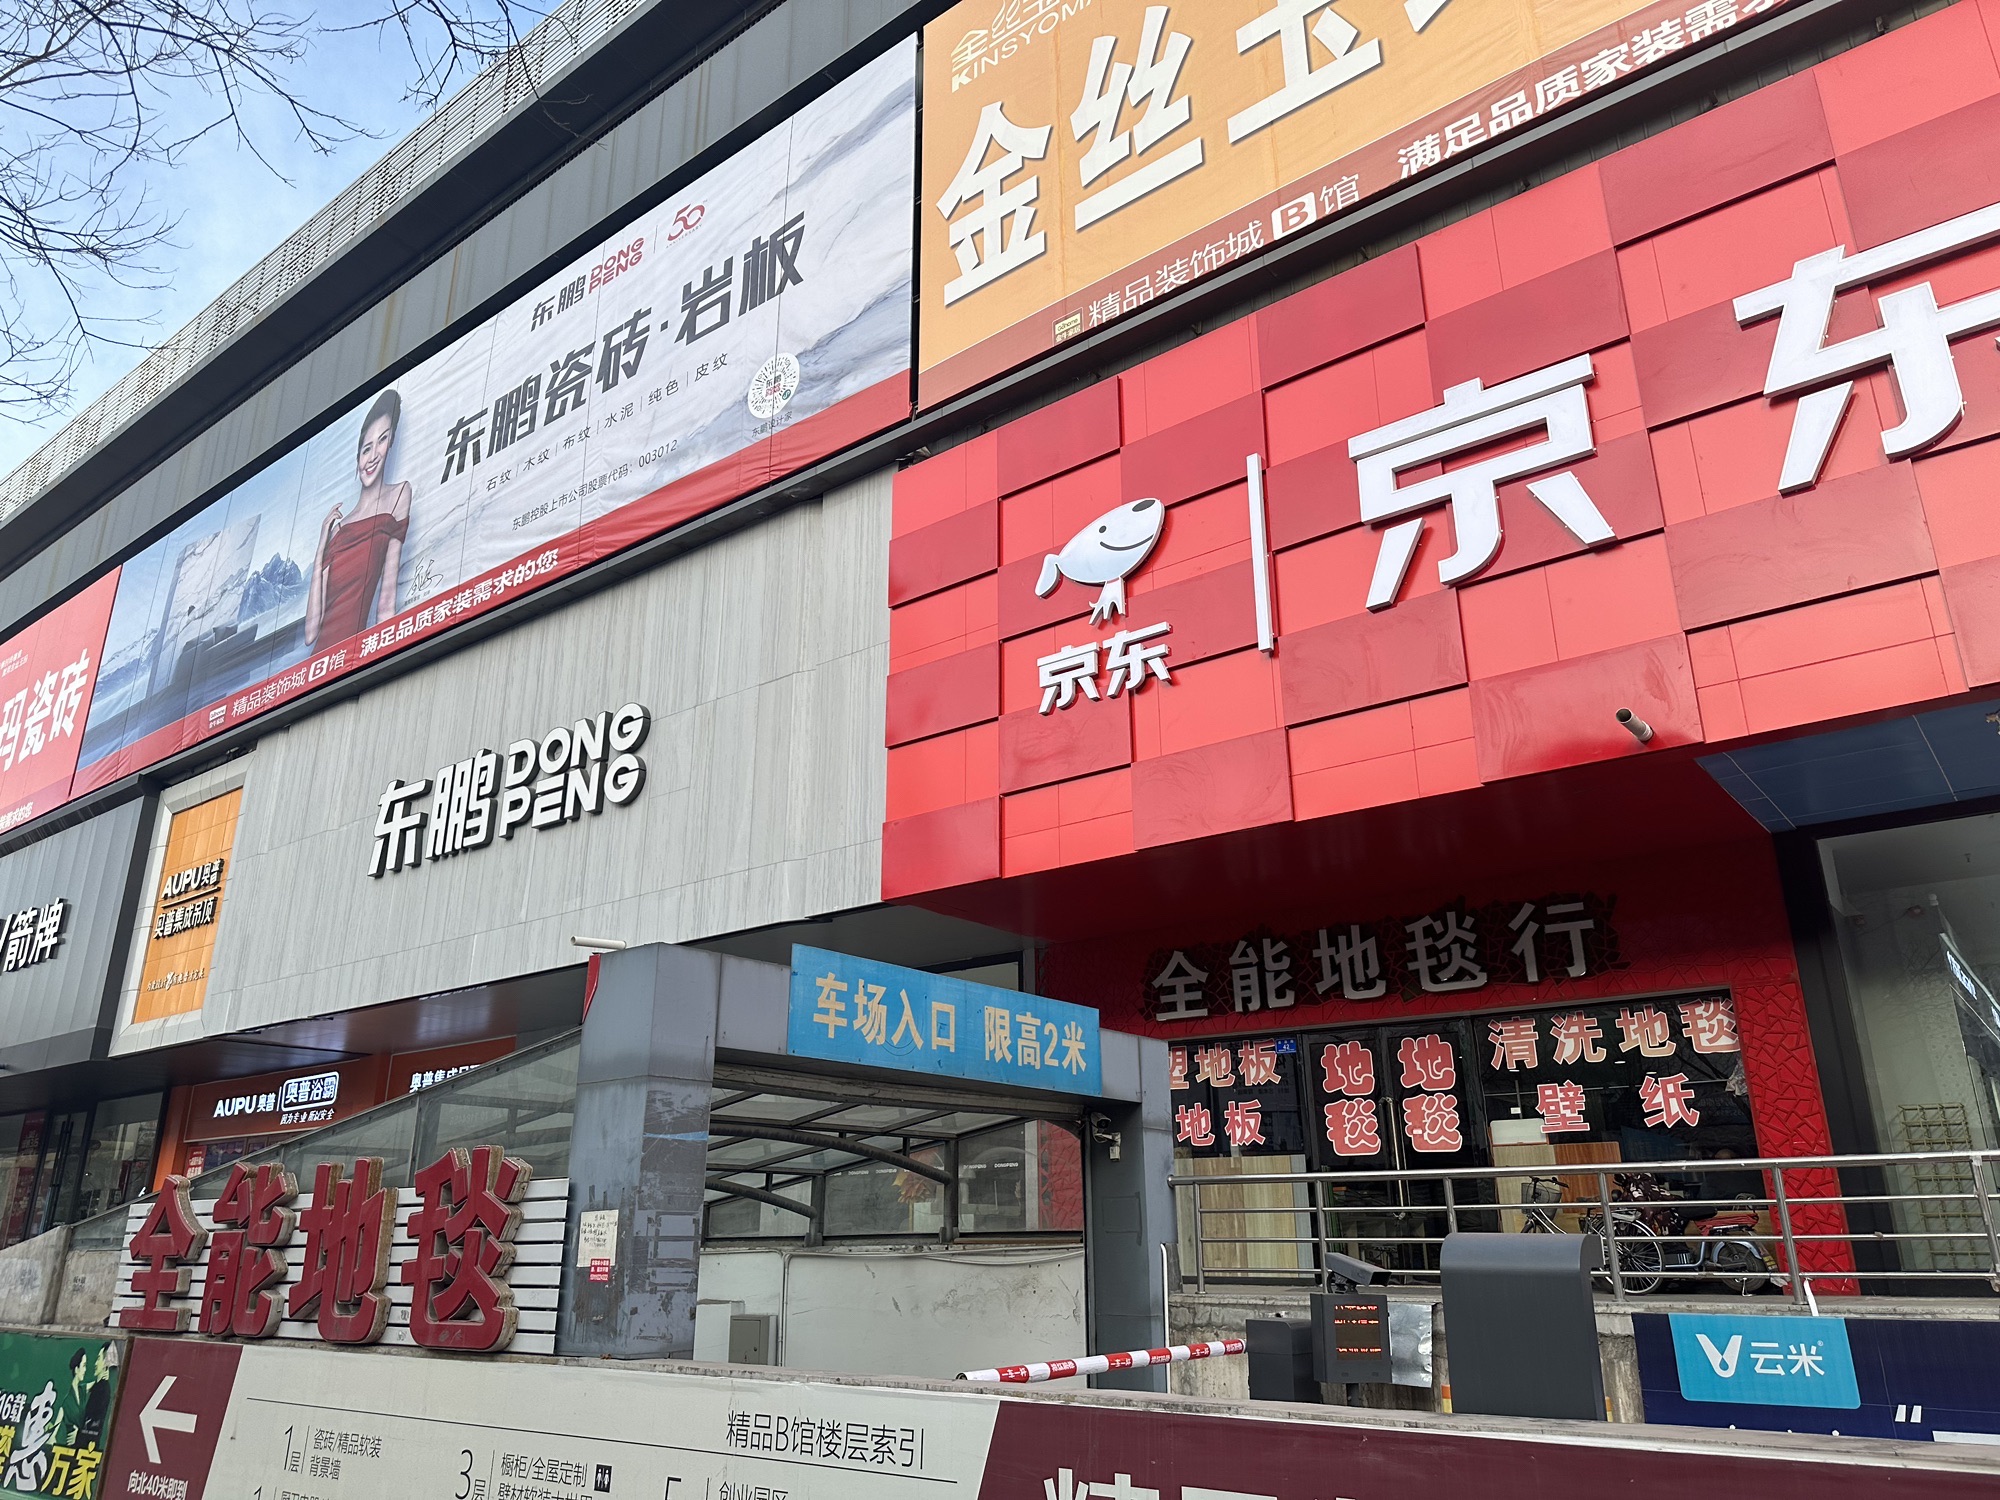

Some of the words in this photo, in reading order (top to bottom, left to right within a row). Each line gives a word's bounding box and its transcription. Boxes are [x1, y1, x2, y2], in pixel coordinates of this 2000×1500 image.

[951, 0, 1092, 94] KINSYOM
[936, 0, 1453, 307] 金丝玉
[588, 251, 643, 294] PENG
[590, 237, 645, 280] DONG
[530, 274, 587, 332] 东鹏
[486, 469, 512, 493] 石纹
[523, 448, 550, 471] 木纹
[562, 427, 591, 450] 布纹
[603, 402, 634, 429] 水泥
[648, 379, 679, 406] 纯色
[694, 353, 728, 383] 皮纹
[638, 439, 678, 468] 003012
[359, 547, 559, 659] 满足品质家装需求的您
[1036, 621, 1173, 715] 京东
[505, 702, 651, 790] DONG
[367, 747, 503, 878] 东鹏
[498, 752, 647, 840] PENG
[1151, 901, 1596, 1022] 全能地毯行
[812, 971, 956, 1054] 车场入口
[983, 1005, 1088, 1076] 限高2米
[1487, 997, 1742, 1071] 清洗地毯
[285, 1077, 337, 1105] 奥普浴霸
[409, 1064, 481, 1094] 奥普集
[1320, 1040, 1382, 1157] 地毯
[1397, 1033, 1463, 1153] 地毯
[1175, 1099, 1266, 1147] 地板
[119, 1145, 533, 1351] 全能地毯
[1749, 1341, 1826, 1378] 云米
[308, 1454, 342, 1481] 背景墙
[313, 1427, 383, 1459] 瓷砖/精品软装
[500, 1451, 588, 1488] 橱柜/全屋定制
[725, 1409, 925, 1470] 精品B馆楼层索引
